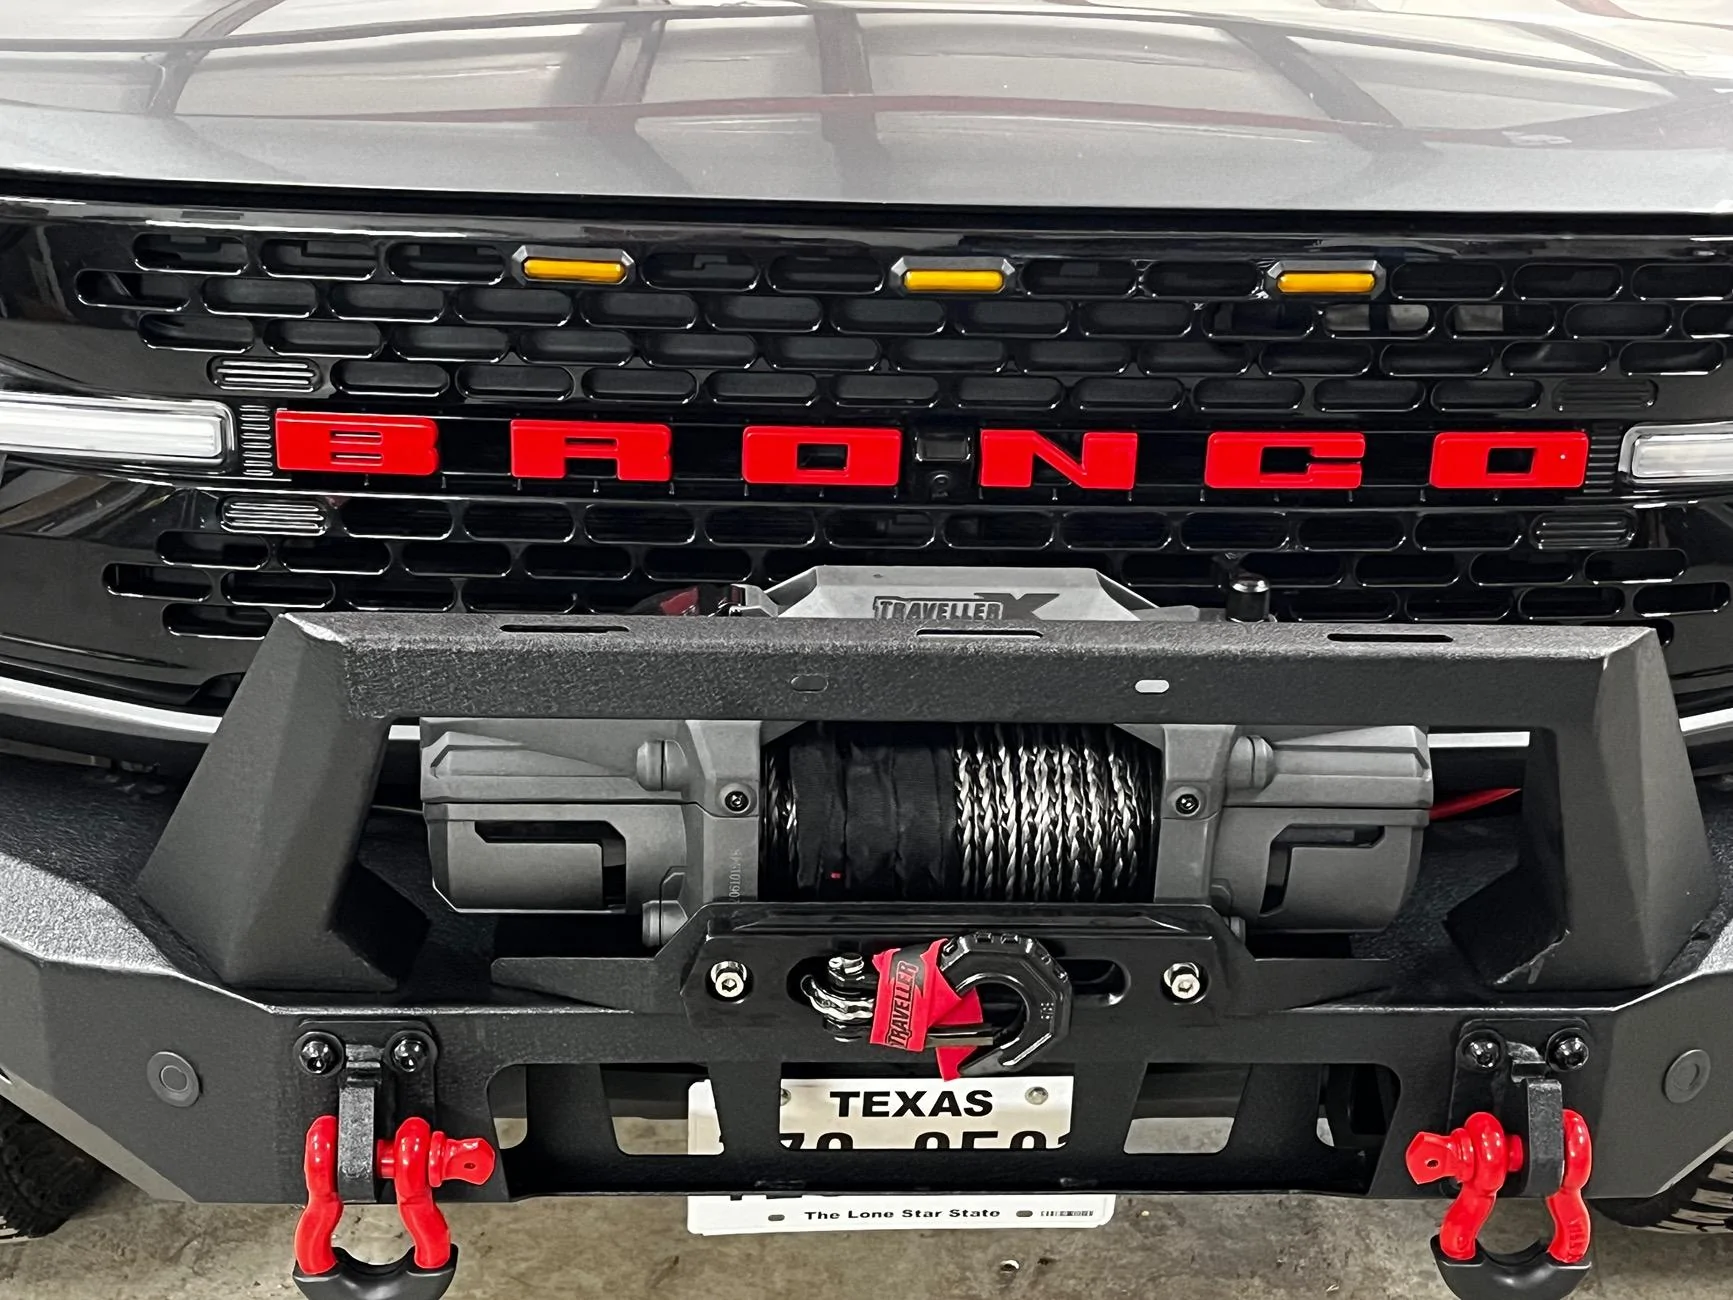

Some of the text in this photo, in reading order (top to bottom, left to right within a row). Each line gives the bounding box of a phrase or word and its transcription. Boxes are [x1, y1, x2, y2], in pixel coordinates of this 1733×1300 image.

[275, 410, 1589, 490] BRONCO
[874, 597, 1004, 620] TRAVELLER
[885, 960, 919, 1048] TRAVELLER
[830, 1090, 993, 1117] TEXAS
[804, 1206, 1000, 1220] The Lone Star State
